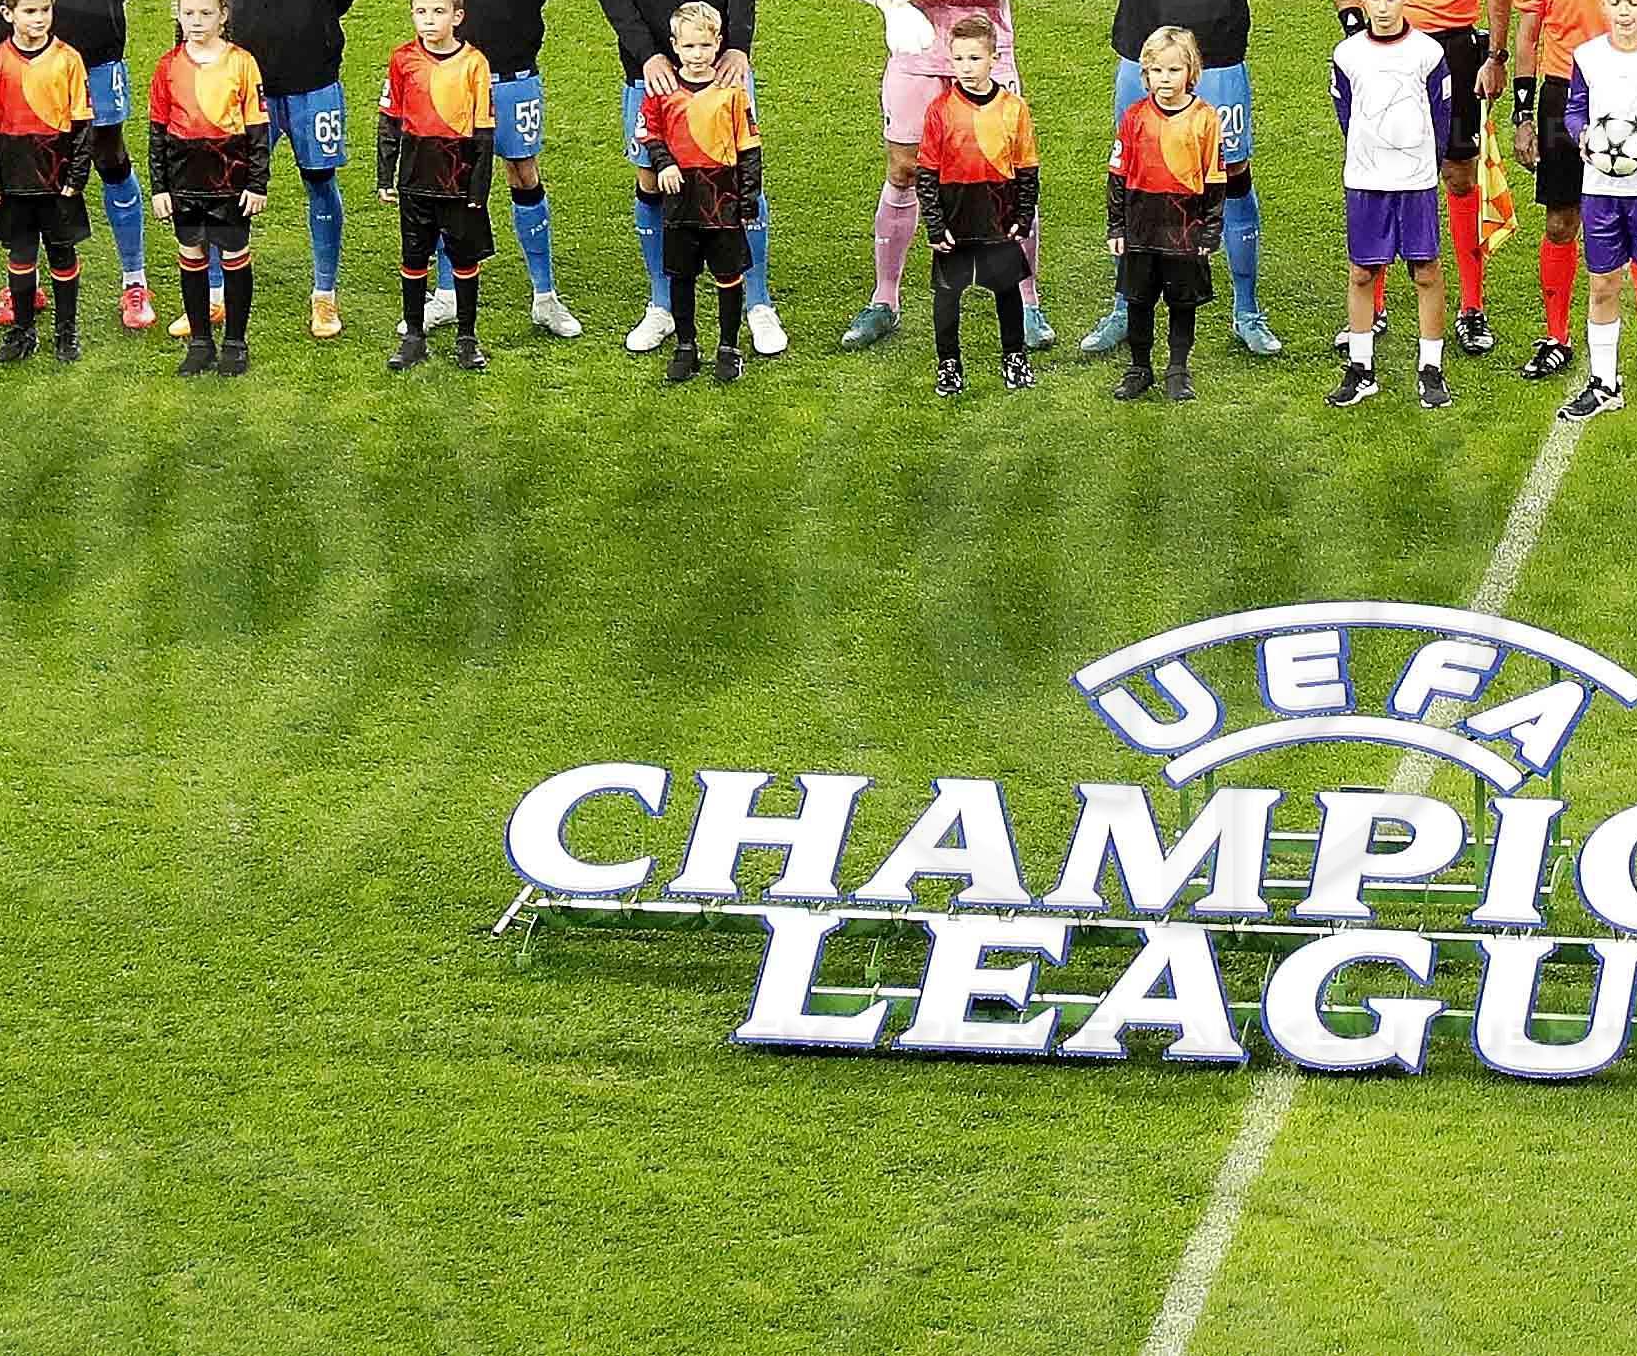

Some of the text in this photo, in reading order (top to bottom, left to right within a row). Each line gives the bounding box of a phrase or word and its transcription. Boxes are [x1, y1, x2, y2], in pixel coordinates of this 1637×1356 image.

[314, 110, 342, 143] 65
[515, 99, 541, 134] 55
[1217, 103, 1244, 138] 20
[1092, 624, 1592, 780] UEFA
